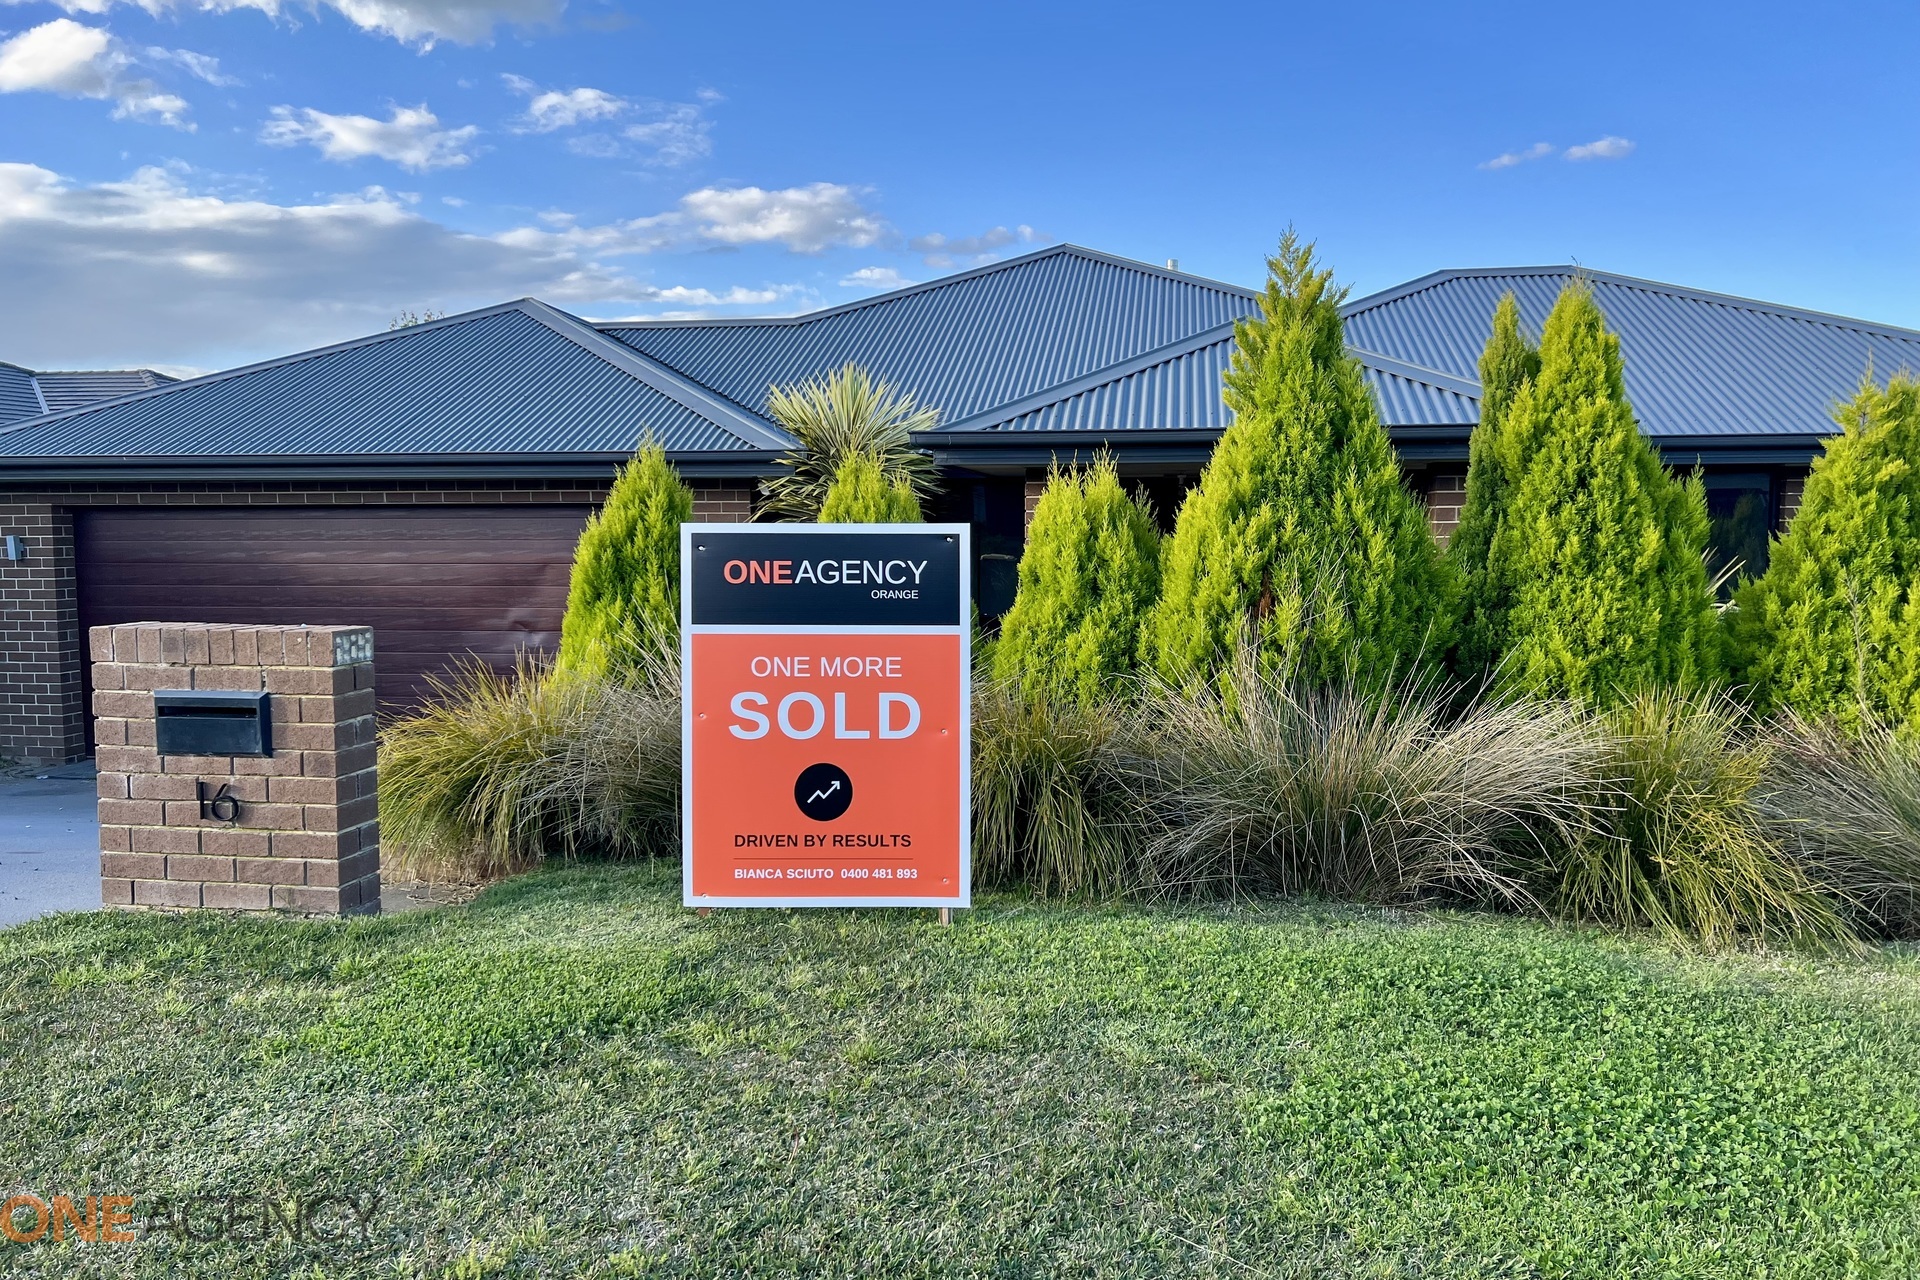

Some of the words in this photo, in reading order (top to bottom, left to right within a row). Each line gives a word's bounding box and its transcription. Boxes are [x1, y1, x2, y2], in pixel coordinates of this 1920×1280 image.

[870, 589, 919, 600] ORANGE
[750, 656, 810, 678] ONE
[820, 656, 903, 678] MORE
[728, 691, 922, 740] SOLD
[195, 781, 240, 821] 16
[733, 834, 799, 848] DRIVEN
[803, 834, 827, 848] BY
[832, 834, 912, 848] RESULTS
[733, 868, 783, 880] BIANCA
[786, 868, 834, 880] SCIUTO
[840, 868, 870, 880] 0400
[872, 868, 893, 880] 481
[896, 868, 918, 880] 893
